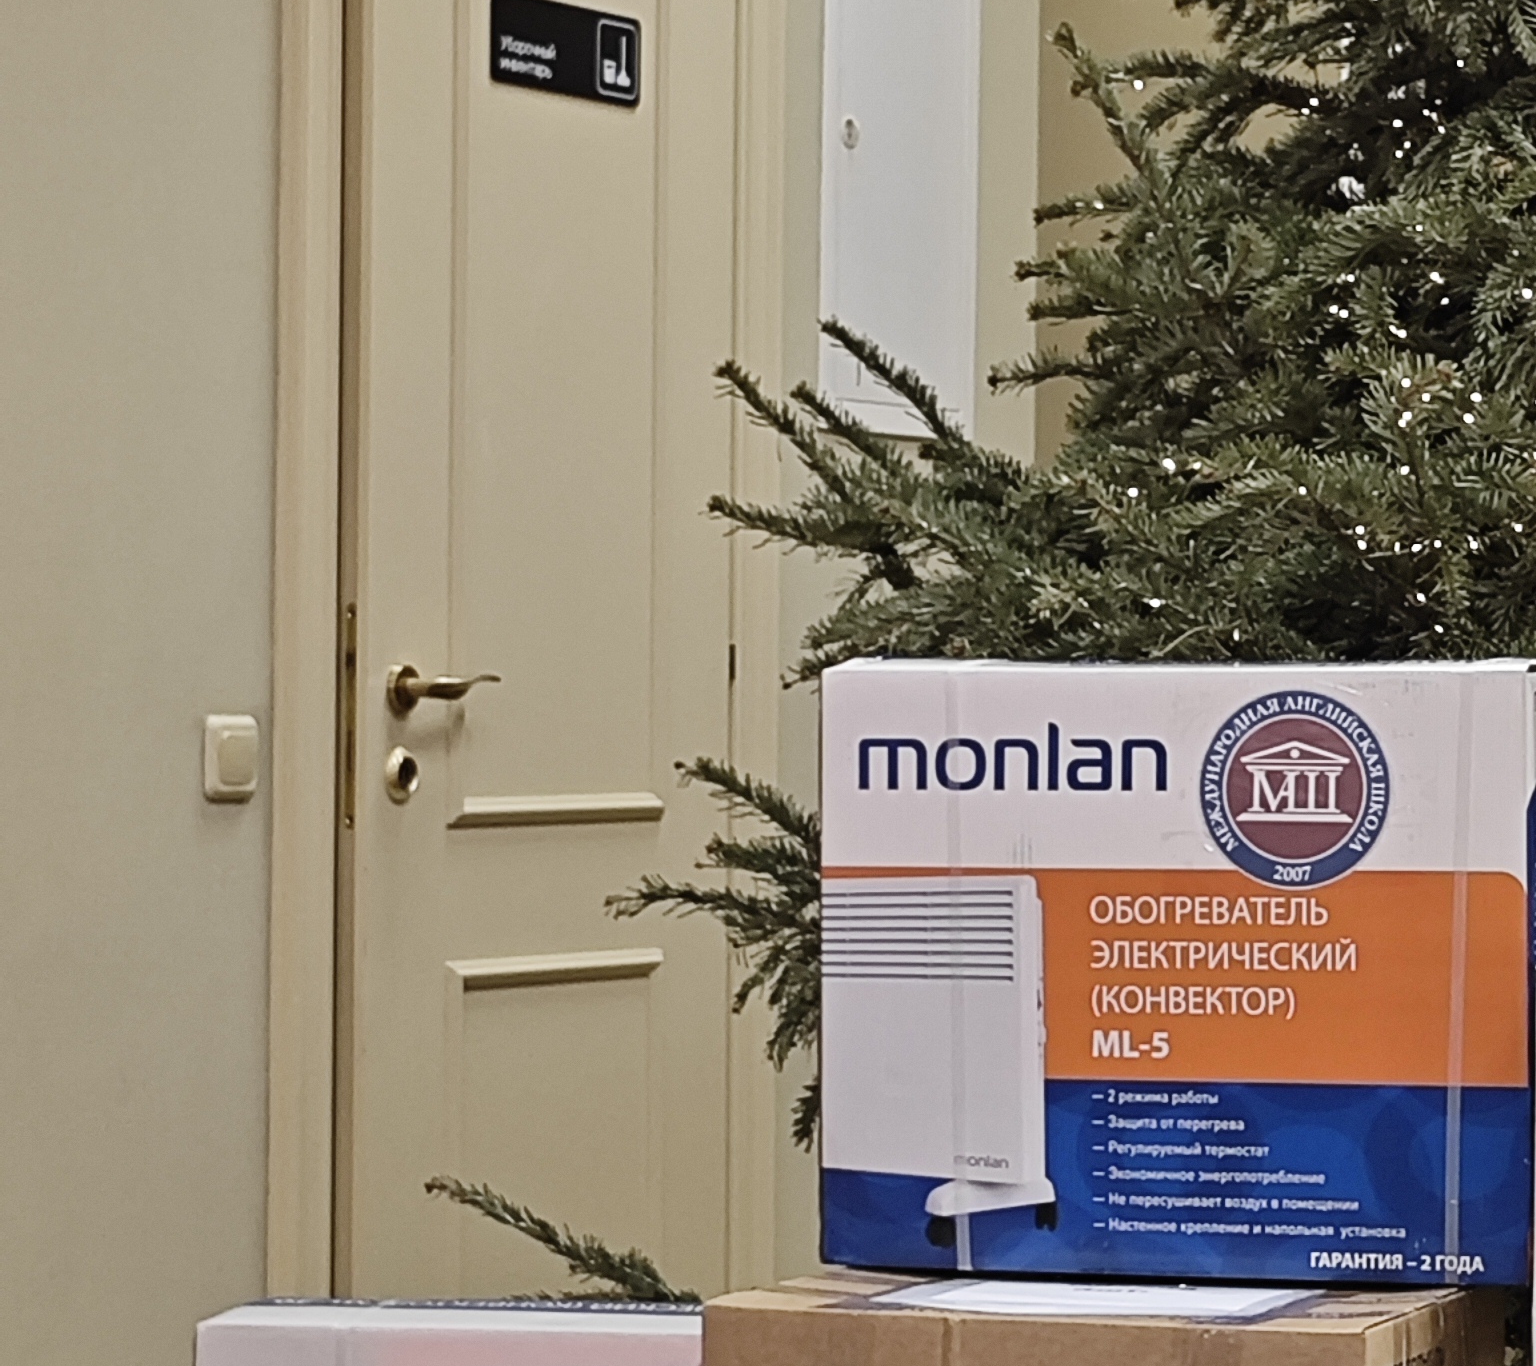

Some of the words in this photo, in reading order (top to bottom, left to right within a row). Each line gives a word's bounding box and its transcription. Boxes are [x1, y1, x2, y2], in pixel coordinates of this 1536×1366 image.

[858, 721, 1167, 791] monlan
[1204, 697, 1280, 852] МЕЖДУНАРОДНАЯ
[1283, 696, 1385, 778] АНГЛИЙСКАЯ
[1348, 782, 1386, 853] ШКОЛА
[1273, 865, 1312, 881] 2007
[1089, 895, 1329, 926] ОБОГРЕВАТЕЛЬ
[1090, 938, 1357, 971] ЭЛЕКТРИЧЕСКИЙ
[1091, 984, 1296, 1020] (КОНВЕКТОР)
[1091, 1030, 1170, 1059] ML-5
[1107, 1090, 1115, 1103] 2
[1118, 1092, 1169, 1106] режима
[1171, 1091, 1219, 1106] работы
[1107, 1117, 1158, 1132] Защита
[1160, 1119, 1174, 1130] от
[1176, 1119, 1245, 1134] перегрева
[1107, 1141, 1202, 1157] Регулируемый
[1204, 1145, 1270, 1159] термостат
[1107, 1167, 1196, 1182] Экономичное
[1198, 1168, 1326, 1186] энергопотребление
[1108, 1193, 1126, 1206] Не
[1129, 1195, 1222, 1211] пересушивает
[1224, 1197, 1268, 1212] воздух
[1282, 1199, 1360, 1213] помещении
[1108, 1218, 1178, 1233] Настенное
[1180, 1222, 1250, 1237] крепление
[1264, 1223, 1334, 1237] напольная
[1340, 1225, 1406, 1240] установка
[1309, 1252, 1403, 1271] ГАРАНТИЯ
[1420, 1256, 1431, 1272] 2
[1435, 1256, 1484, 1275] ГОДА
